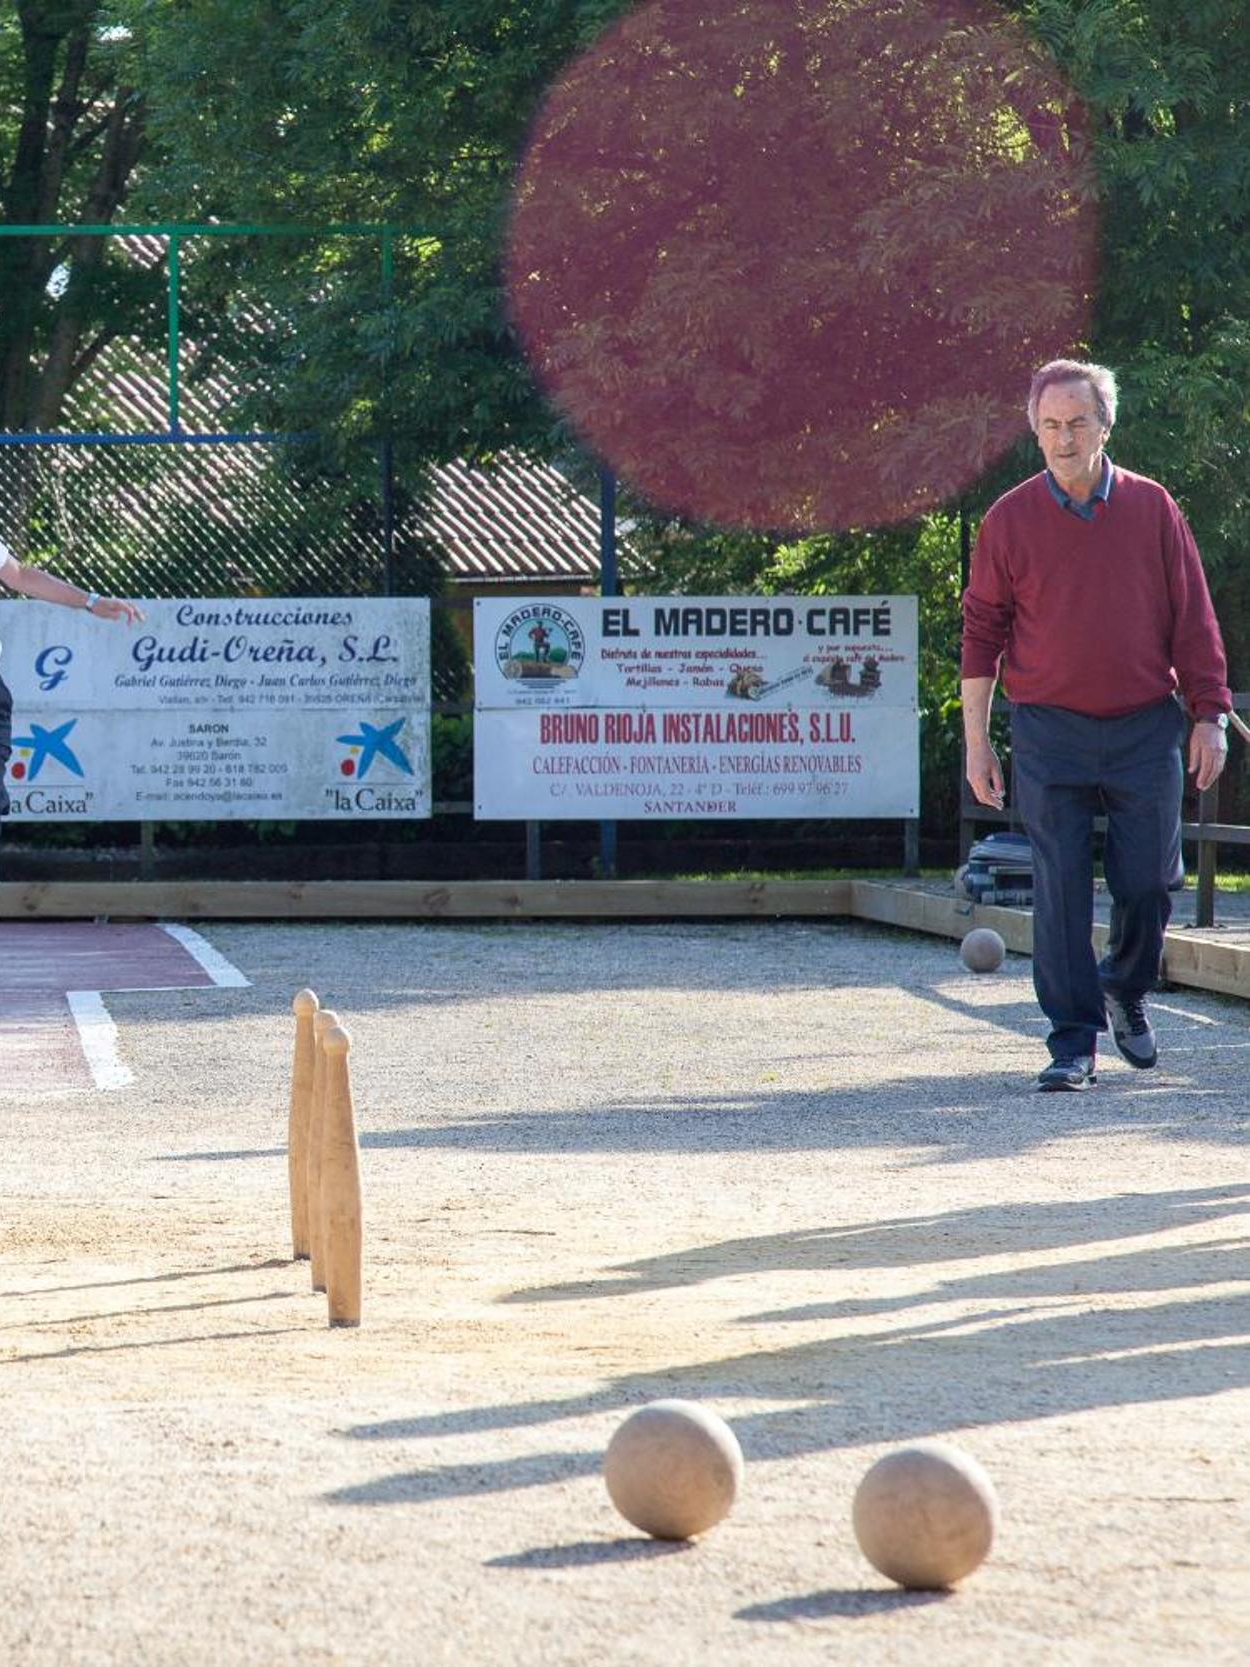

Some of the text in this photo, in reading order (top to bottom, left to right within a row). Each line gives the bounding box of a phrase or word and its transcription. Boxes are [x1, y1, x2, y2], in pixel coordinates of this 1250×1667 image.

[176, 604, 353, 627] Construcciones
[602, 607, 640, 638] EL
[131, 635, 398, 673] Gudi-Oreña, S.L.
[641, 648, 653, 660] de
[655, 649, 692, 660] nuestras
[34, 645, 73, 692] G
[616, 662, 662, 674] Tortillas
[679, 662, 714, 673] Jamón
[729, 663, 764, 673] Queso
[114, 674, 156, 688] Gabriel
[214, 674, 247, 689] Diego
[257, 674, 286, 688] Juan
[290, 674, 326, 687] Carlos
[384, 674, 417, 689] Diego
[625, 677, 680, 689] Mejillones
[540, 712, 856, 747] BRUNO RIOJA INSTALACIONES, S.L.U.
[533, 751, 620, 774] CALEFACCIÓN
[719, 751, 781, 774] ENERGÍAS
[782, 755, 862, 774] RENOVABLES
[575, 783, 666, 798] VALDENOJA,
[670, 783, 684, 795] 22
[711, 783, 723, 795] D
[644, 801, 737, 813] SANTANDER
